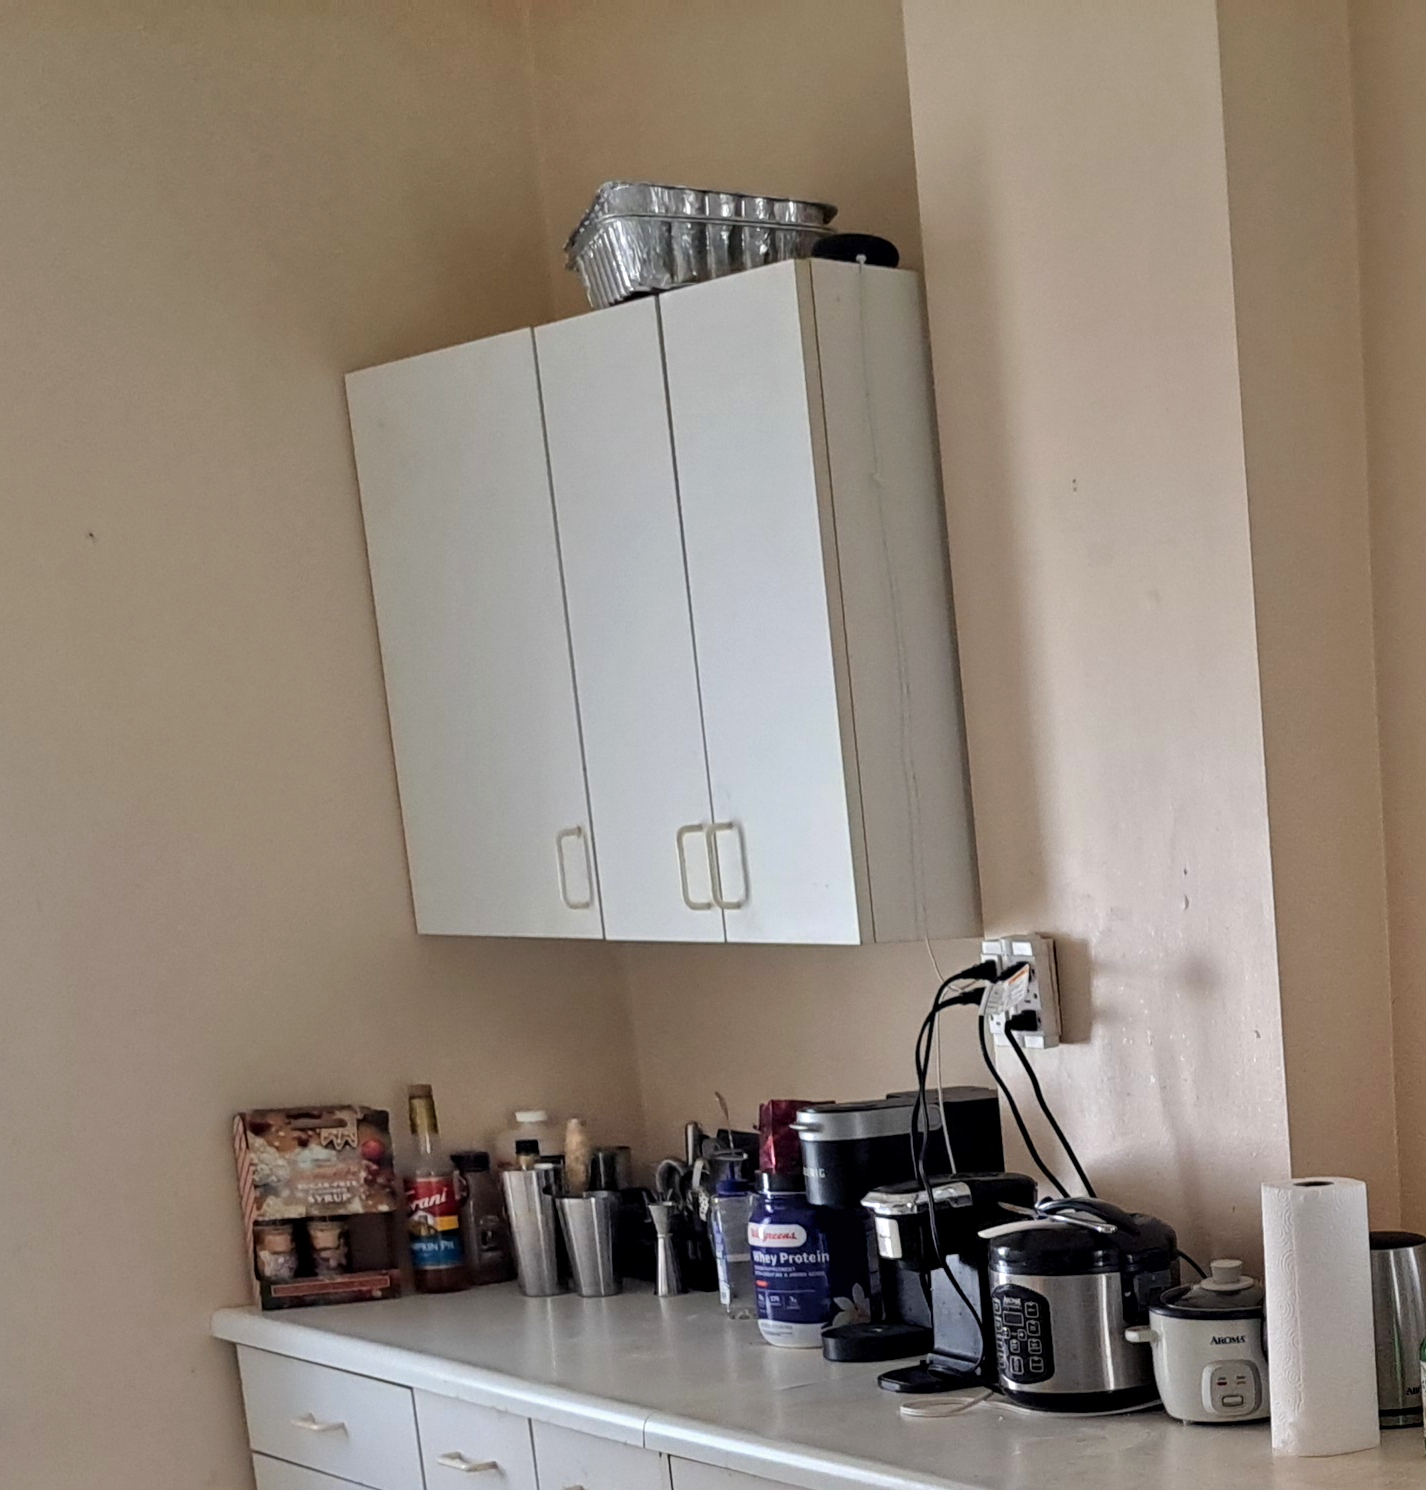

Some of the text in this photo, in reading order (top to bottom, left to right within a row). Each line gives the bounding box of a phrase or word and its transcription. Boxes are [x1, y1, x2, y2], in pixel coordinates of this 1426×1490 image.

[307, 1193, 352, 1204] SYRUP
[753, 1250, 830, 1266] Whey Protein
[1210, 1335, 1247, 1345] AROMA
